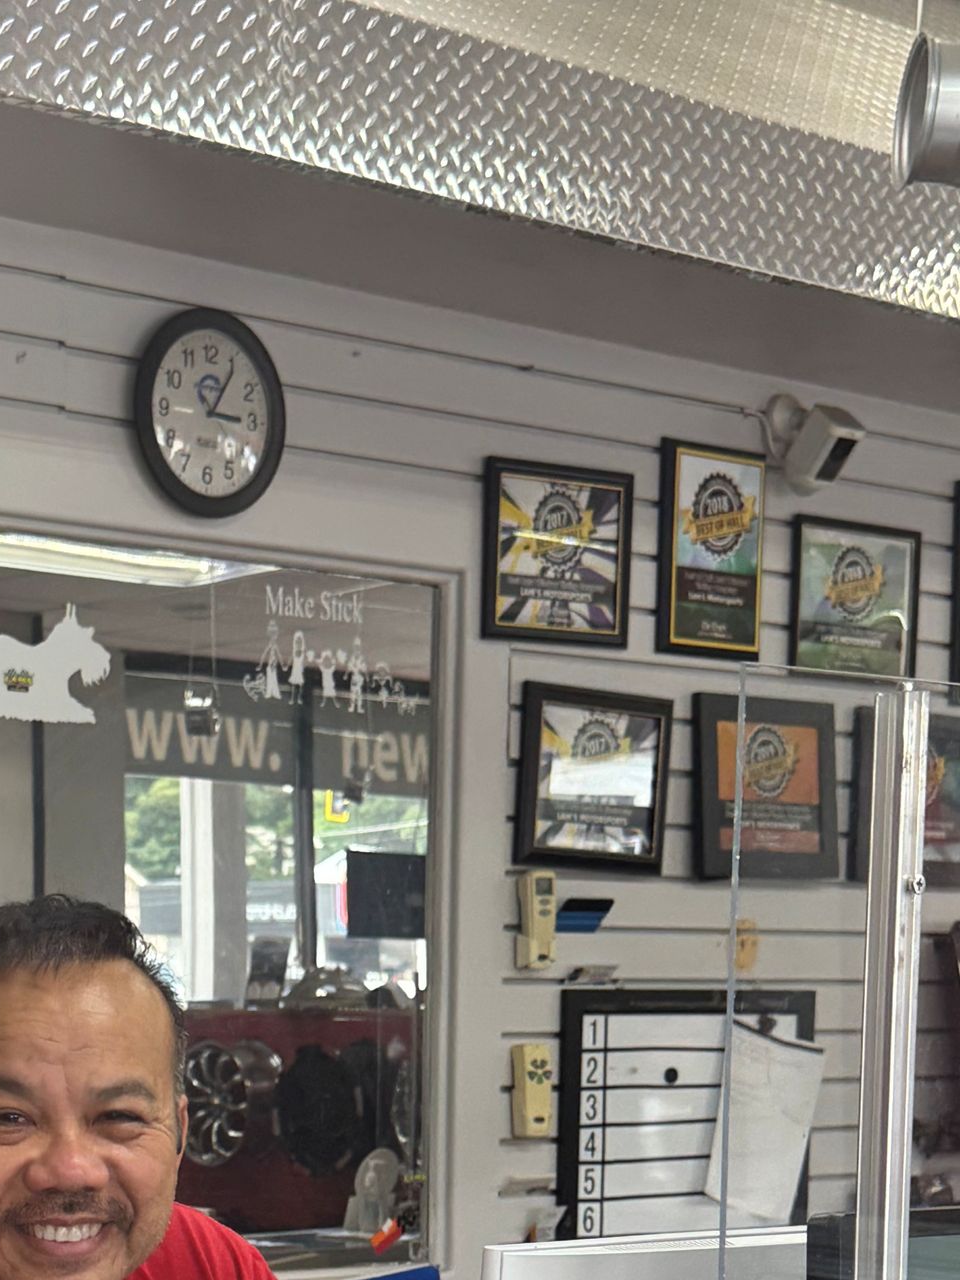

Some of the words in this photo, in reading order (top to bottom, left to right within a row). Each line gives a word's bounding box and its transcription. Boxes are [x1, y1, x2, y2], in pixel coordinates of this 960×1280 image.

[182, 348, 195, 367] 11
[203, 344, 219, 365] 12
[166, 370, 182, 389] 10
[244, 382, 254, 402] 2
[159, 397, 169, 416] 9
[247, 413, 257, 431] 3
[202, 466, 213, 484] 6
[224, 460, 234, 479] 5
[545, 510, 568, 530] 2017
[265, 584, 315, 618] Make
[319, 591, 363, 624] Stick
[126, 707, 282, 773] www.
[589, 1019, 598, 1046] 1
[587, 1057, 599, 1085] 2
[585, 1094, 598, 1122] 3
[584, 1131, 597, 1158] 4
[583, 1169, 596, 1196] 5
[582, 1207, 595, 1235] 6
